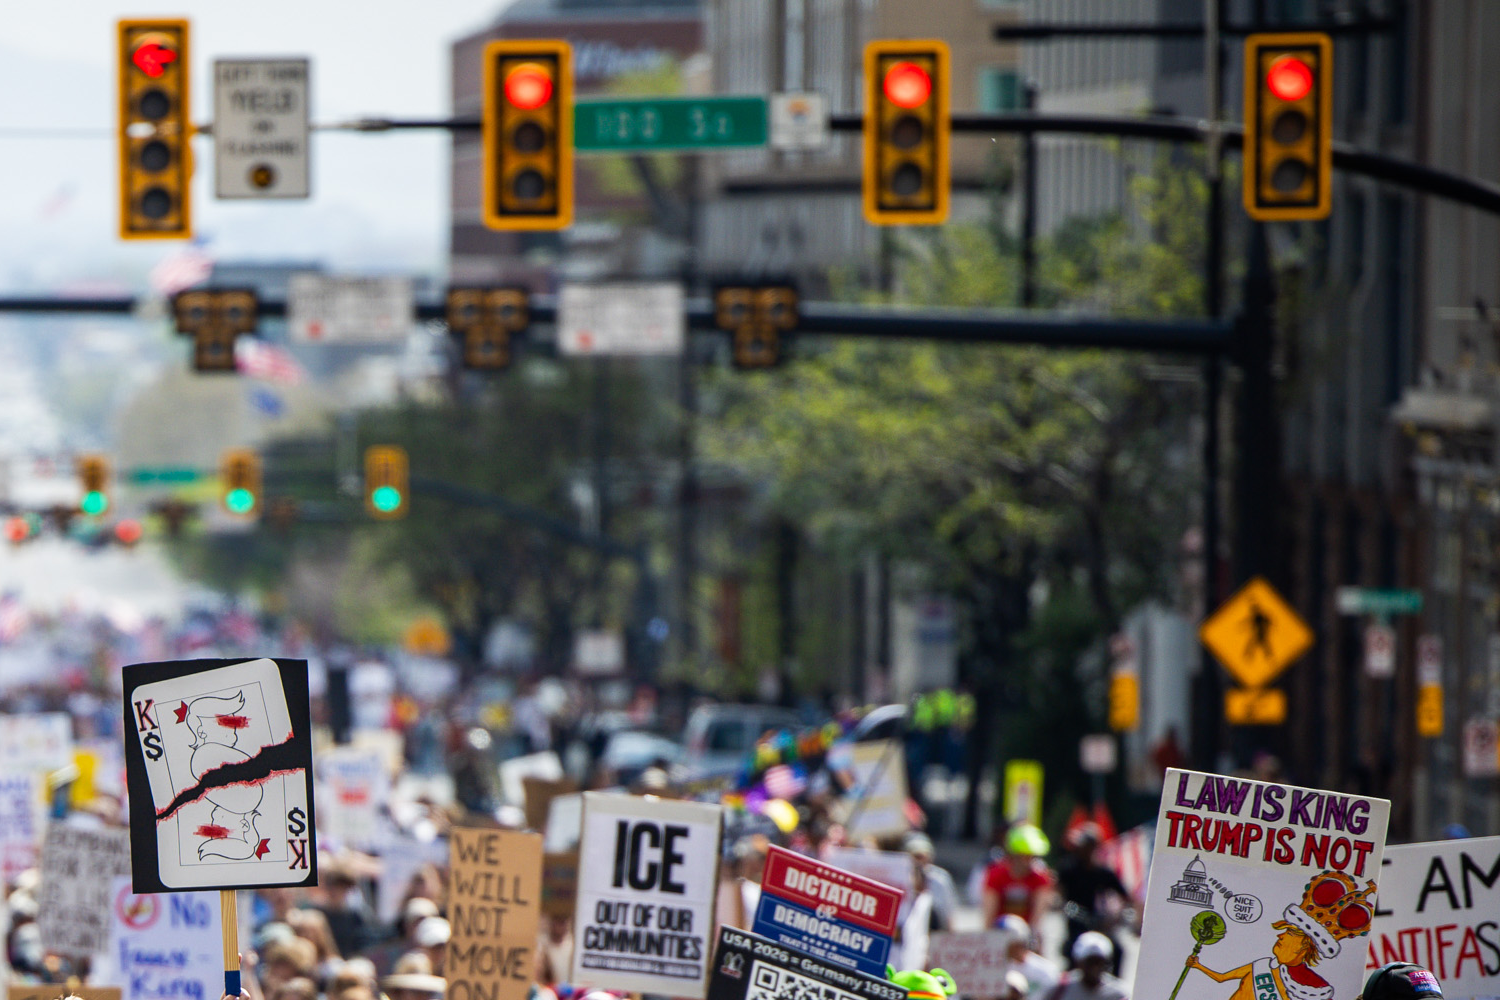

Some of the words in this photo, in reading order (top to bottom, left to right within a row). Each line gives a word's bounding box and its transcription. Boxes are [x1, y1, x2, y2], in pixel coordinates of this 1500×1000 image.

[1175, 772, 1252, 816] LAW
[1251, 784, 1287, 823] IS
[1288, 789, 1371, 836] KING
[454, 833, 499, 866] WE
[612, 819, 690, 895] ICE
[1166, 810, 1263, 858] TRUMP
[1263, 826, 1296, 865] IS
[1301, 832, 1375, 878] NOT
[454, 870, 529, 906] WILL
[784, 866, 878, 917] DICTATOR
[452, 903, 508, 938] NOT
[595, 900, 630, 925] OUT
[633, 904, 655, 928] OF
[657, 906, 693, 933] OUR
[773, 904, 874, 954] DEMOCRACY
[449, 942, 532, 981] MOVE
[584, 925, 703, 961] COMMUNITIES
[723, 931, 752, 951] USA
[752, 939, 790, 963] 2026
[800, 957, 863, 991] Germany
